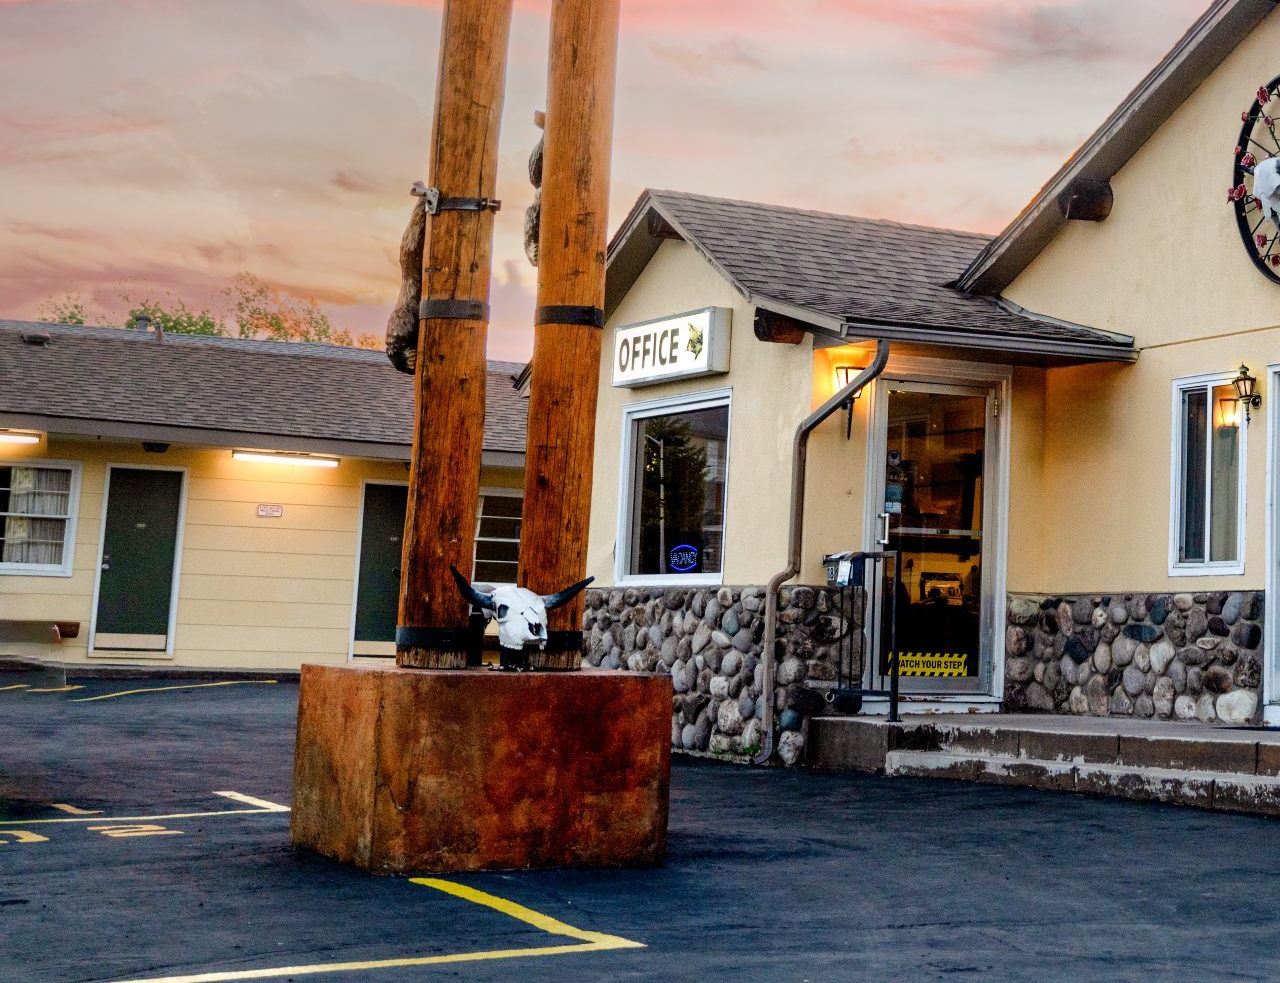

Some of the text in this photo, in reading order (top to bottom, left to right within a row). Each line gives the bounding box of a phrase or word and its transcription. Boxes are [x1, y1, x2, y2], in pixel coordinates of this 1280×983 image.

[619, 328, 680, 373] OFFICE
[899, 659, 963, 670] ATCH YOUR STEP
